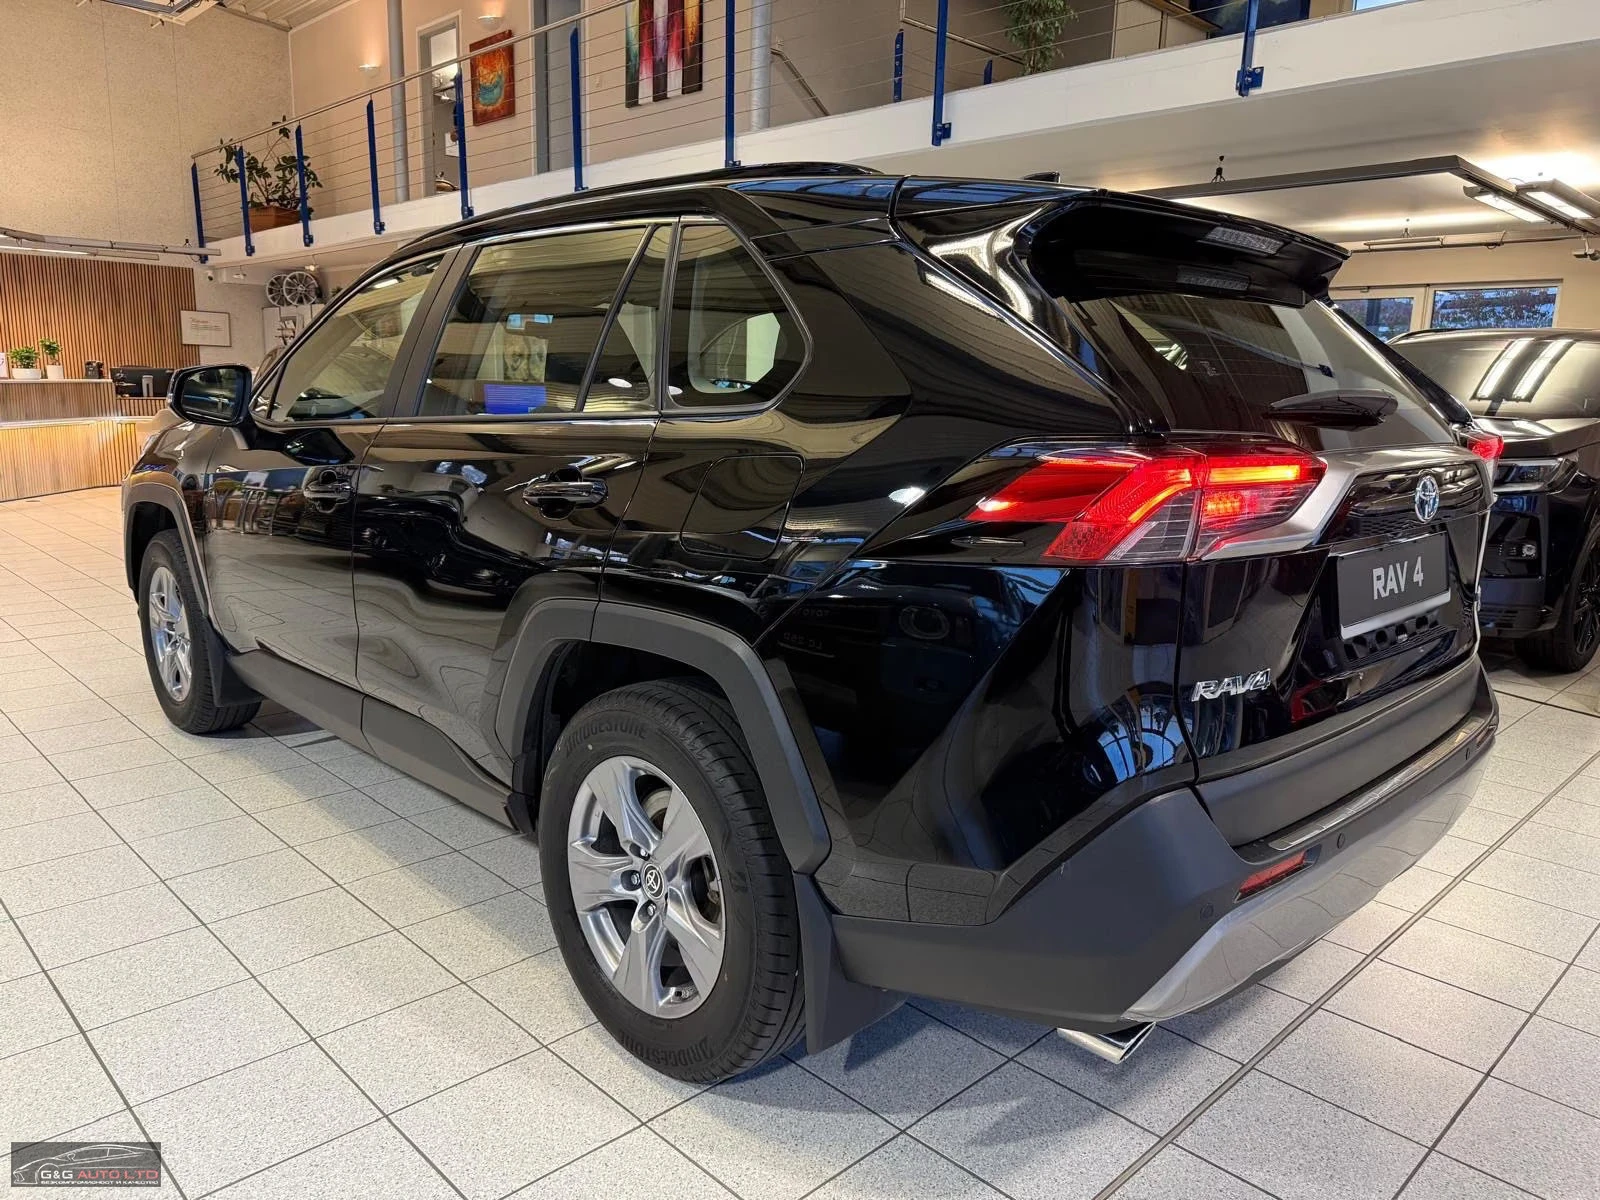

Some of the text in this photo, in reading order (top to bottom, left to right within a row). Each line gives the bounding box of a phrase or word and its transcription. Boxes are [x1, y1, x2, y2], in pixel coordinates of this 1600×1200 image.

[1372, 556, 1424, 600] RAV 4
[1191, 668, 1271, 702] RAV4
[618, 1028, 715, 1067] BRIDGESTONE
